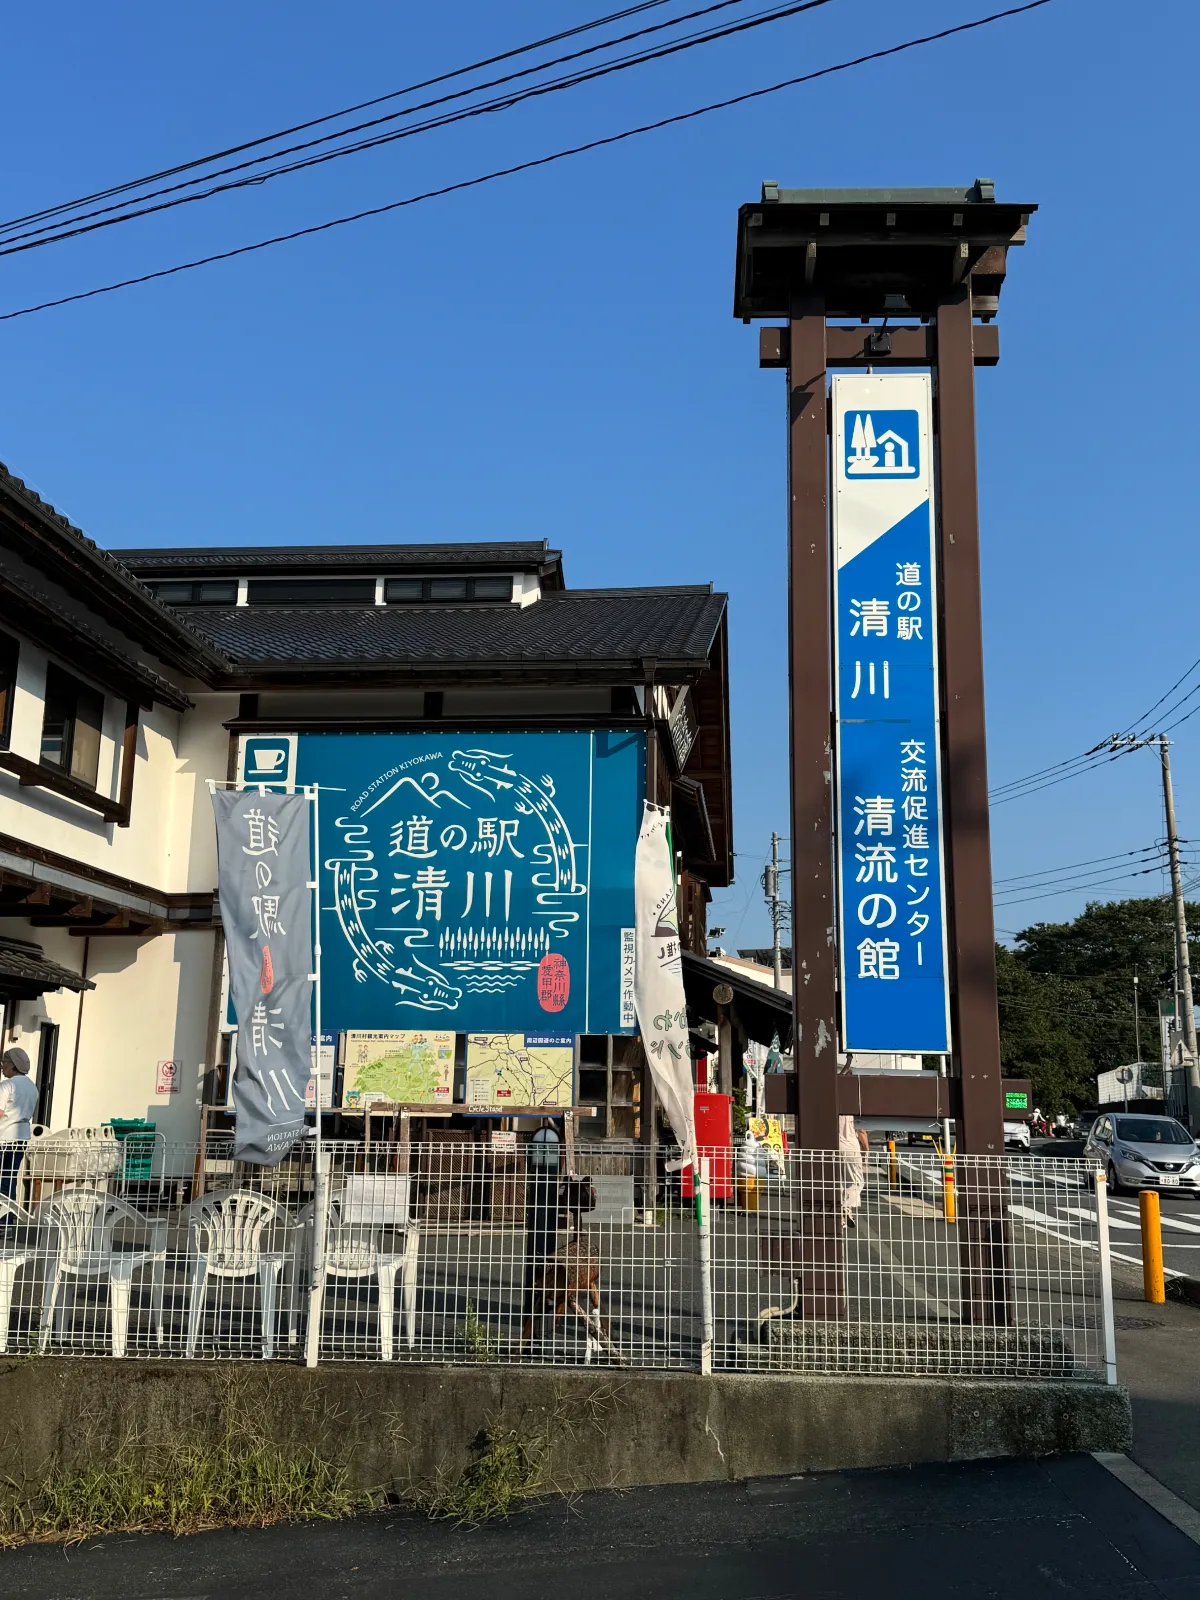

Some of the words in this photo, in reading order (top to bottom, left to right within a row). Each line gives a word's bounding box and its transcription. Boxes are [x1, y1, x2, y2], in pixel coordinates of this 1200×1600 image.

[895, 561, 924, 640] 道の駅
[849, 598, 891, 699] 清川
[350, 790, 370, 812] ROAD
[367, 766, 400, 793] STATION
[398, 751, 443, 771] KIYOKAWA
[388, 815, 525, 859] 道の駅
[900, 739, 930, 966] 交流促進センター
[390, 865, 514, 922] 清川
[853, 795, 900, 980] 清流の館
[623, 931, 635, 1024] 監視カメラ作動中
